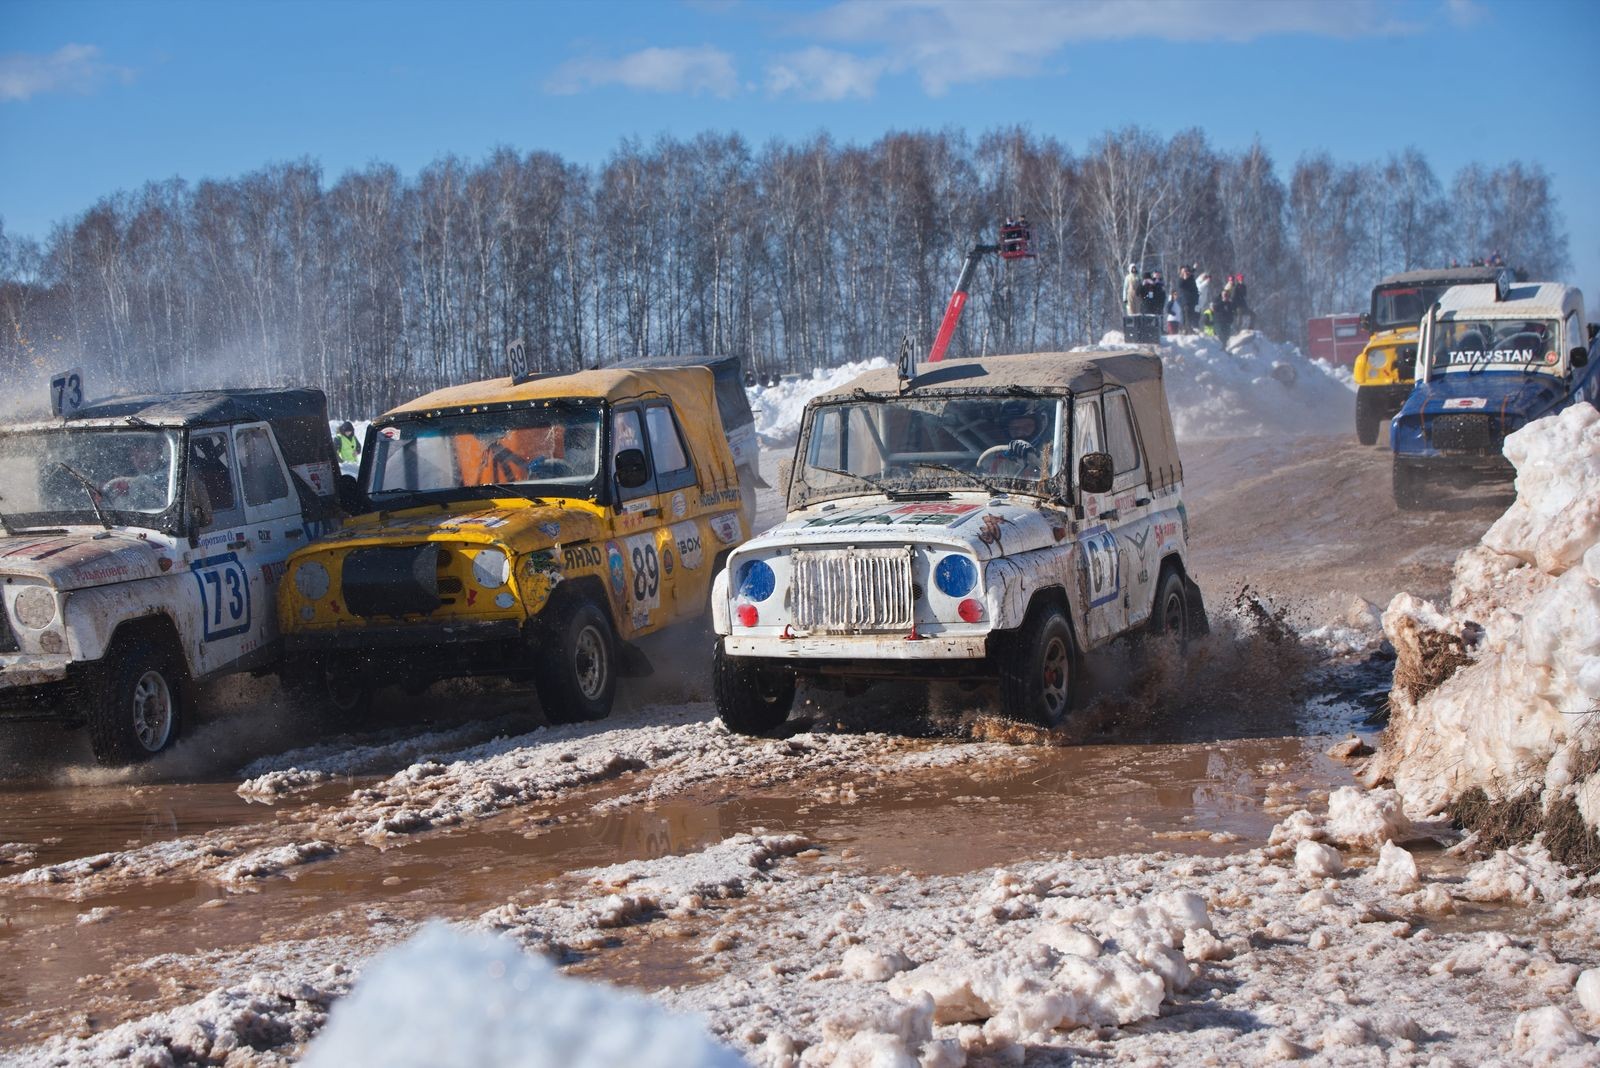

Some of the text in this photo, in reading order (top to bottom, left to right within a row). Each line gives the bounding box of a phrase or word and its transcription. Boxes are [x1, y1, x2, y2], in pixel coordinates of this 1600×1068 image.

[510, 344, 525, 376] 89
[53, 374, 81, 414] 73
[564, 546, 602, 570] ЯНАО
[632, 544, 659, 601] 89
[204, 567, 244, 625] 73
